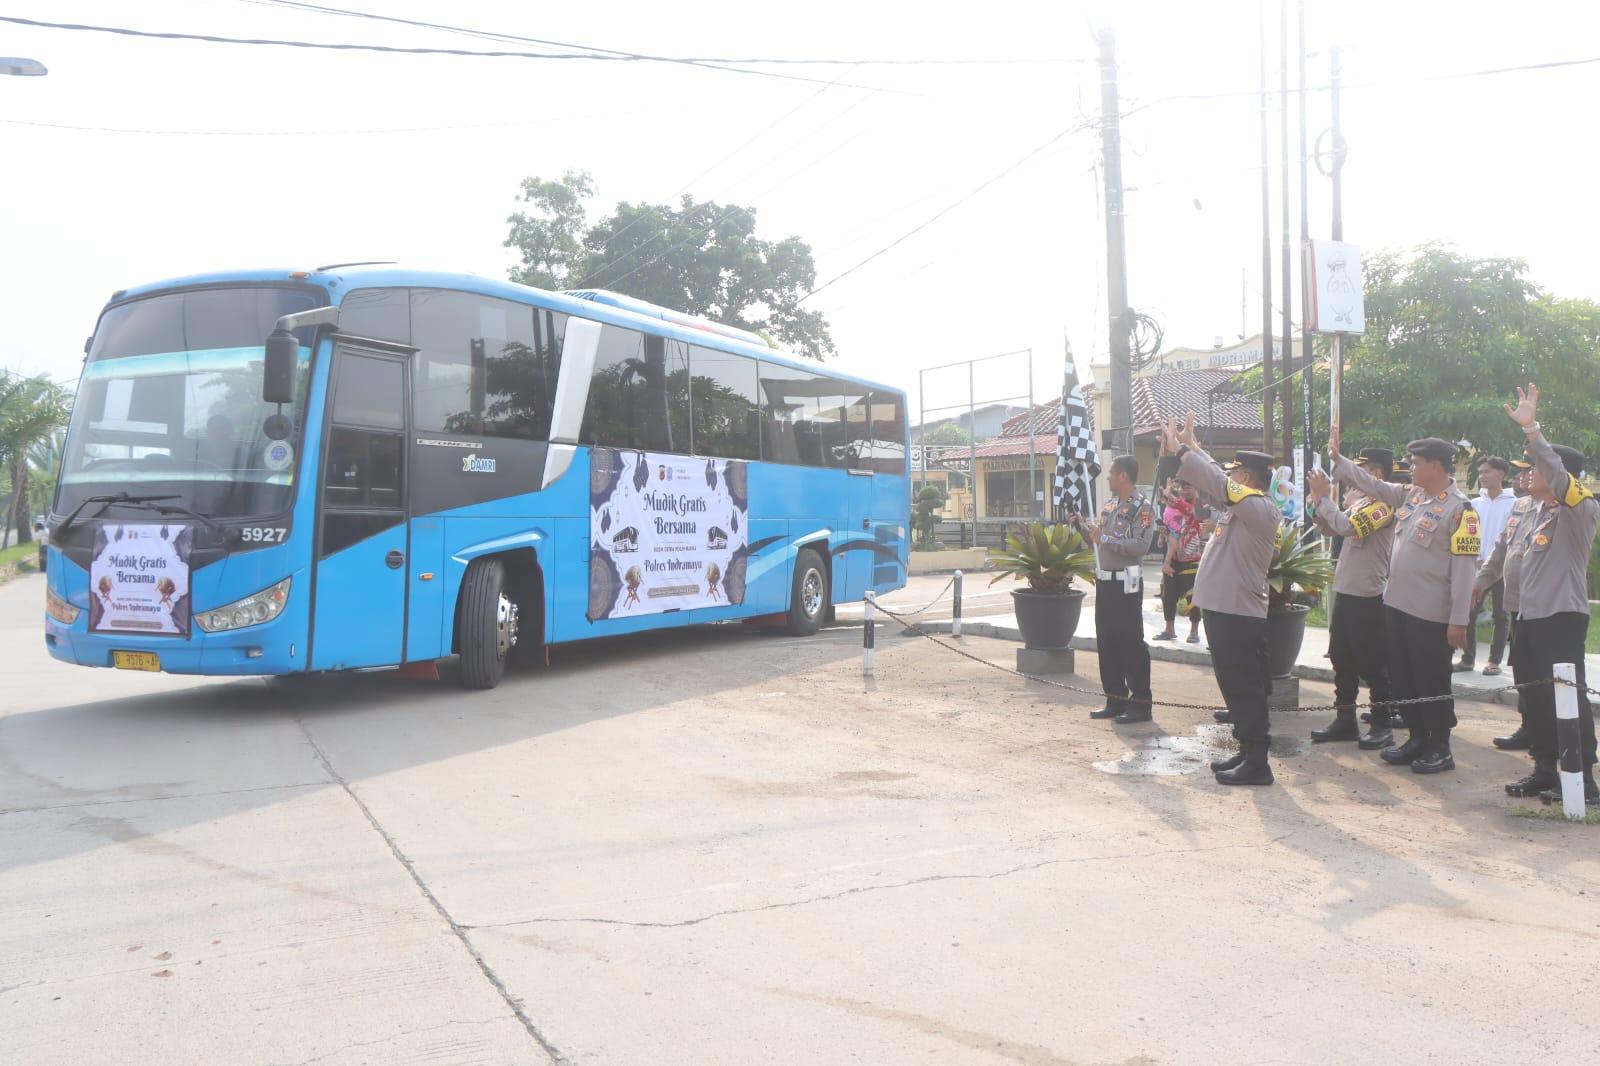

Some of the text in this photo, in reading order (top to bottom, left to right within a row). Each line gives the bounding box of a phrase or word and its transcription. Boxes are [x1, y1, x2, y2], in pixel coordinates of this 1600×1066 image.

[1209, 346, 1282, 368] INDRAMAU
[470, 458, 496, 472] DAMRI
[643, 489, 707, 517] Mudik Gratis
[654, 516, 697, 535] Bersama
[242, 527, 287, 542] 5927
[108, 554, 167, 571] Mudik Gratis
[643, 558, 703, 573] Polres Indramayu
[116, 571, 155, 584] Bersama
